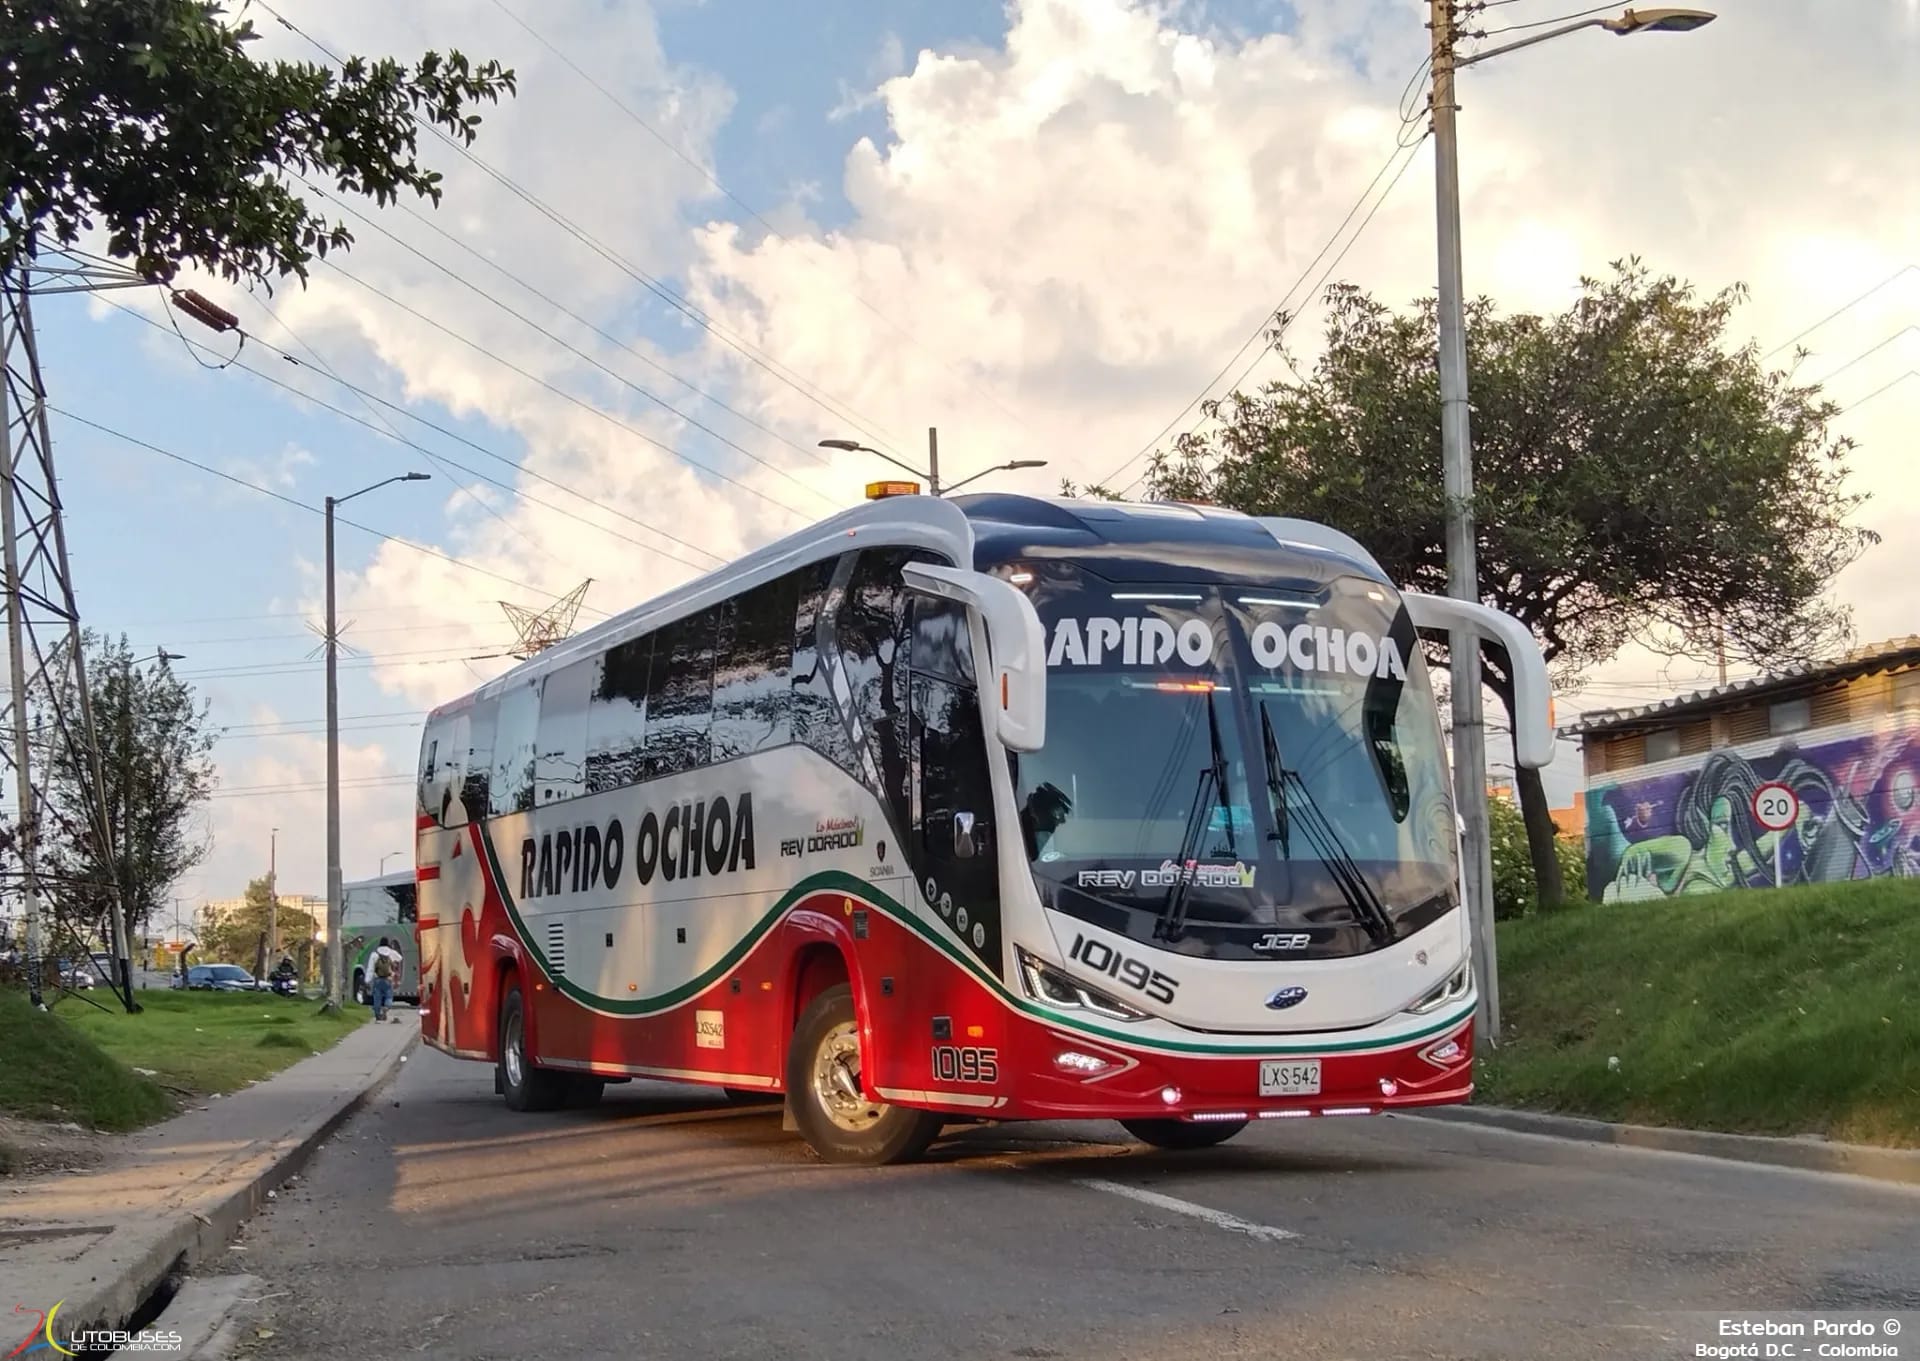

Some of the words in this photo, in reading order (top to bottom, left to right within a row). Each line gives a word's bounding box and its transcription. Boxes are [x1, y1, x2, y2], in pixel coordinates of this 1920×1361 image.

[1040, 617, 1213, 667] APIDO
[1251, 622, 1408, 681] OCHOA
[1763, 799, 1789, 816] 20
[520, 818, 623, 899] RAPIDO
[636, 791, 756, 886] OCHOA
[781, 838, 804, 858] REY
[807, 831, 858, 853] DORADO
[1078, 870, 1136, 889] REY
[1252, 933, 1311, 950] JGB
[1069, 933, 1180, 1004] 10195
[931, 1045, 999, 1085] 10195
